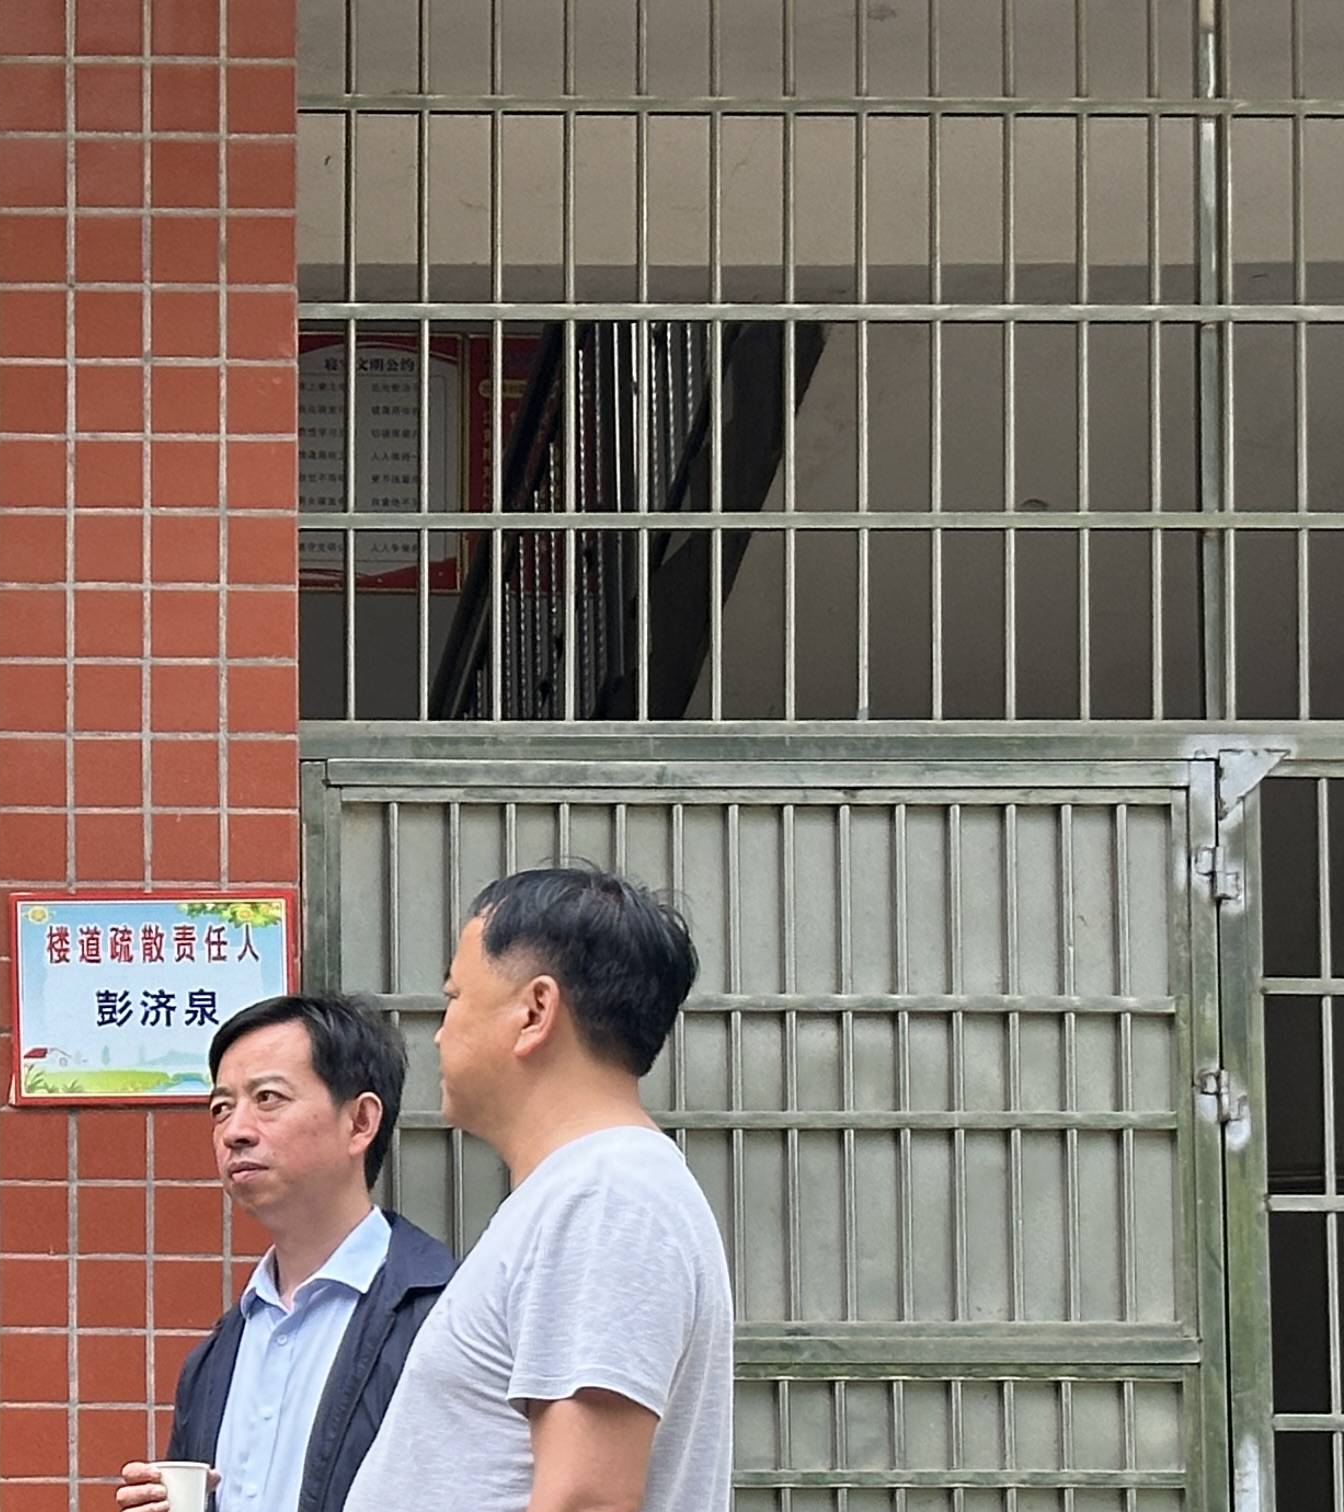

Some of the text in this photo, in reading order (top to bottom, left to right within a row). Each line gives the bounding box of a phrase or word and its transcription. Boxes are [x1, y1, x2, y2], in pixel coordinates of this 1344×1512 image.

[324, 357, 415, 373] 寝文明公约
[46, 924, 260, 964] 楼道疏散责任人
[96, 989, 220, 1028] 彭济泉
